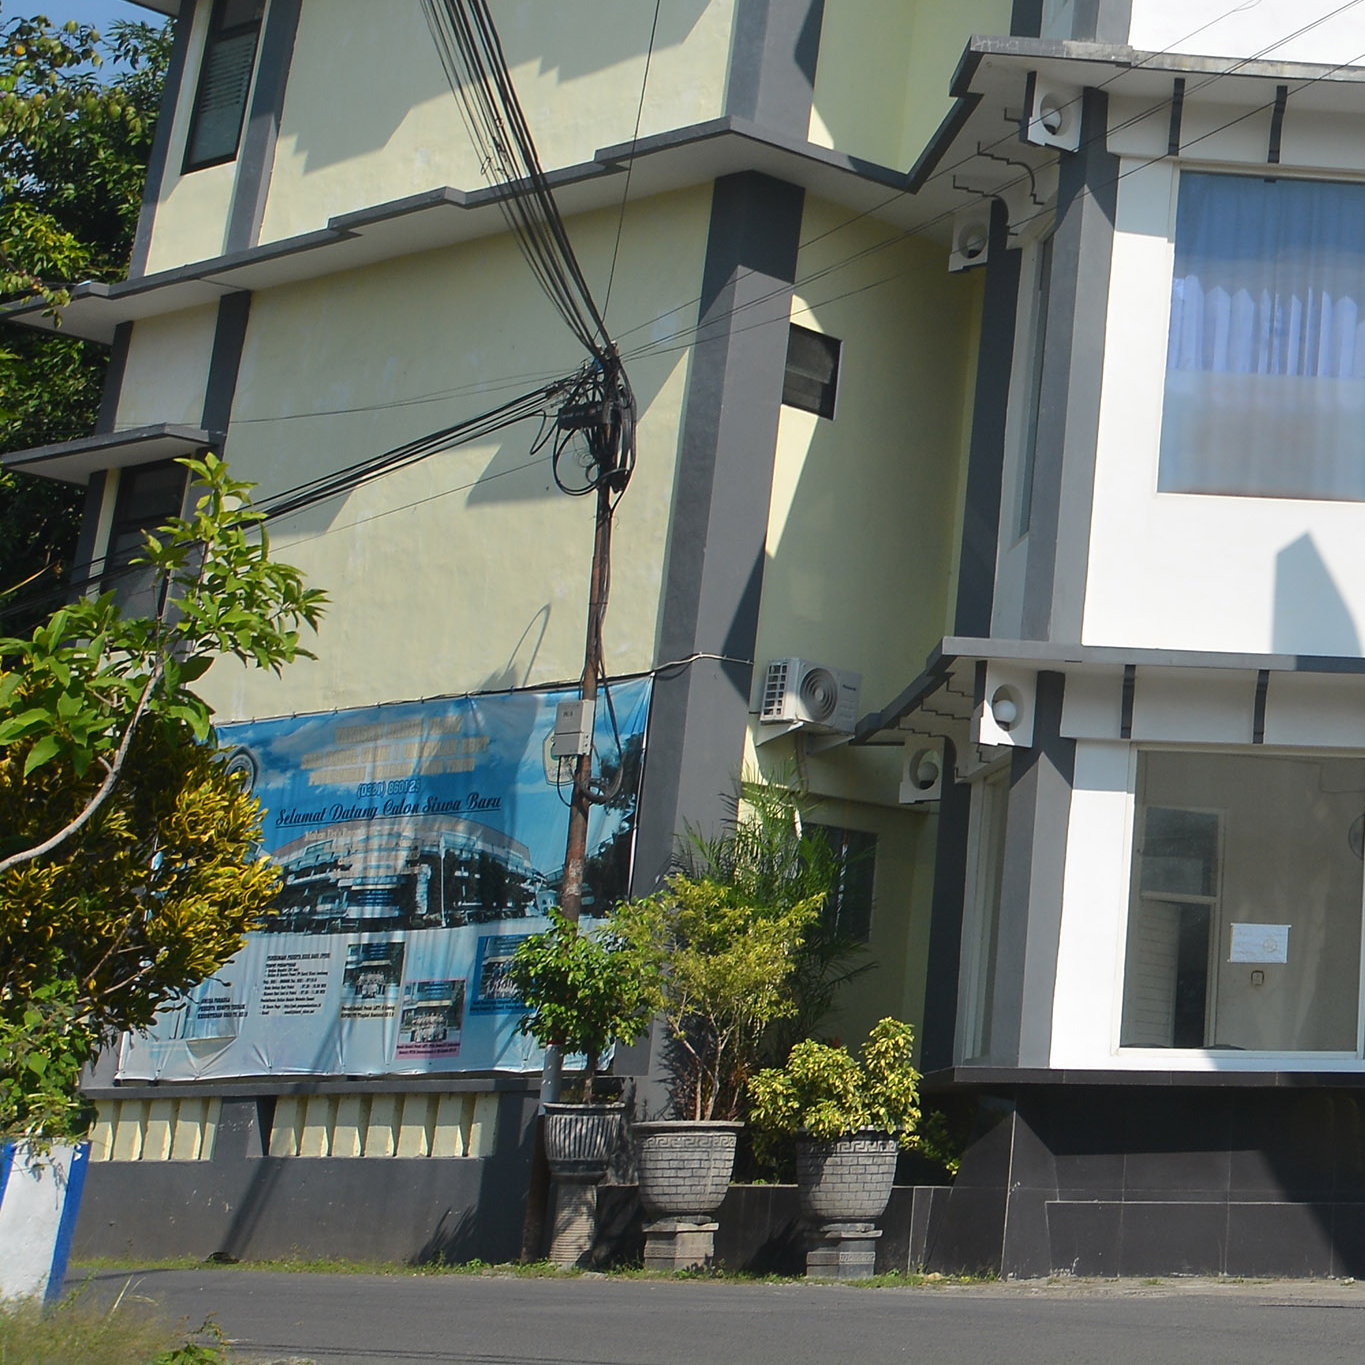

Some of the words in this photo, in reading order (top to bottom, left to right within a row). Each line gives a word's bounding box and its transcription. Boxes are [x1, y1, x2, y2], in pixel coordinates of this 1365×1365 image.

[275, 804, 326, 826] Selamat
[329, 802, 378, 820] Datang
[382, 798, 419, 815] Calon
[465, 791, 501, 809] Baru
